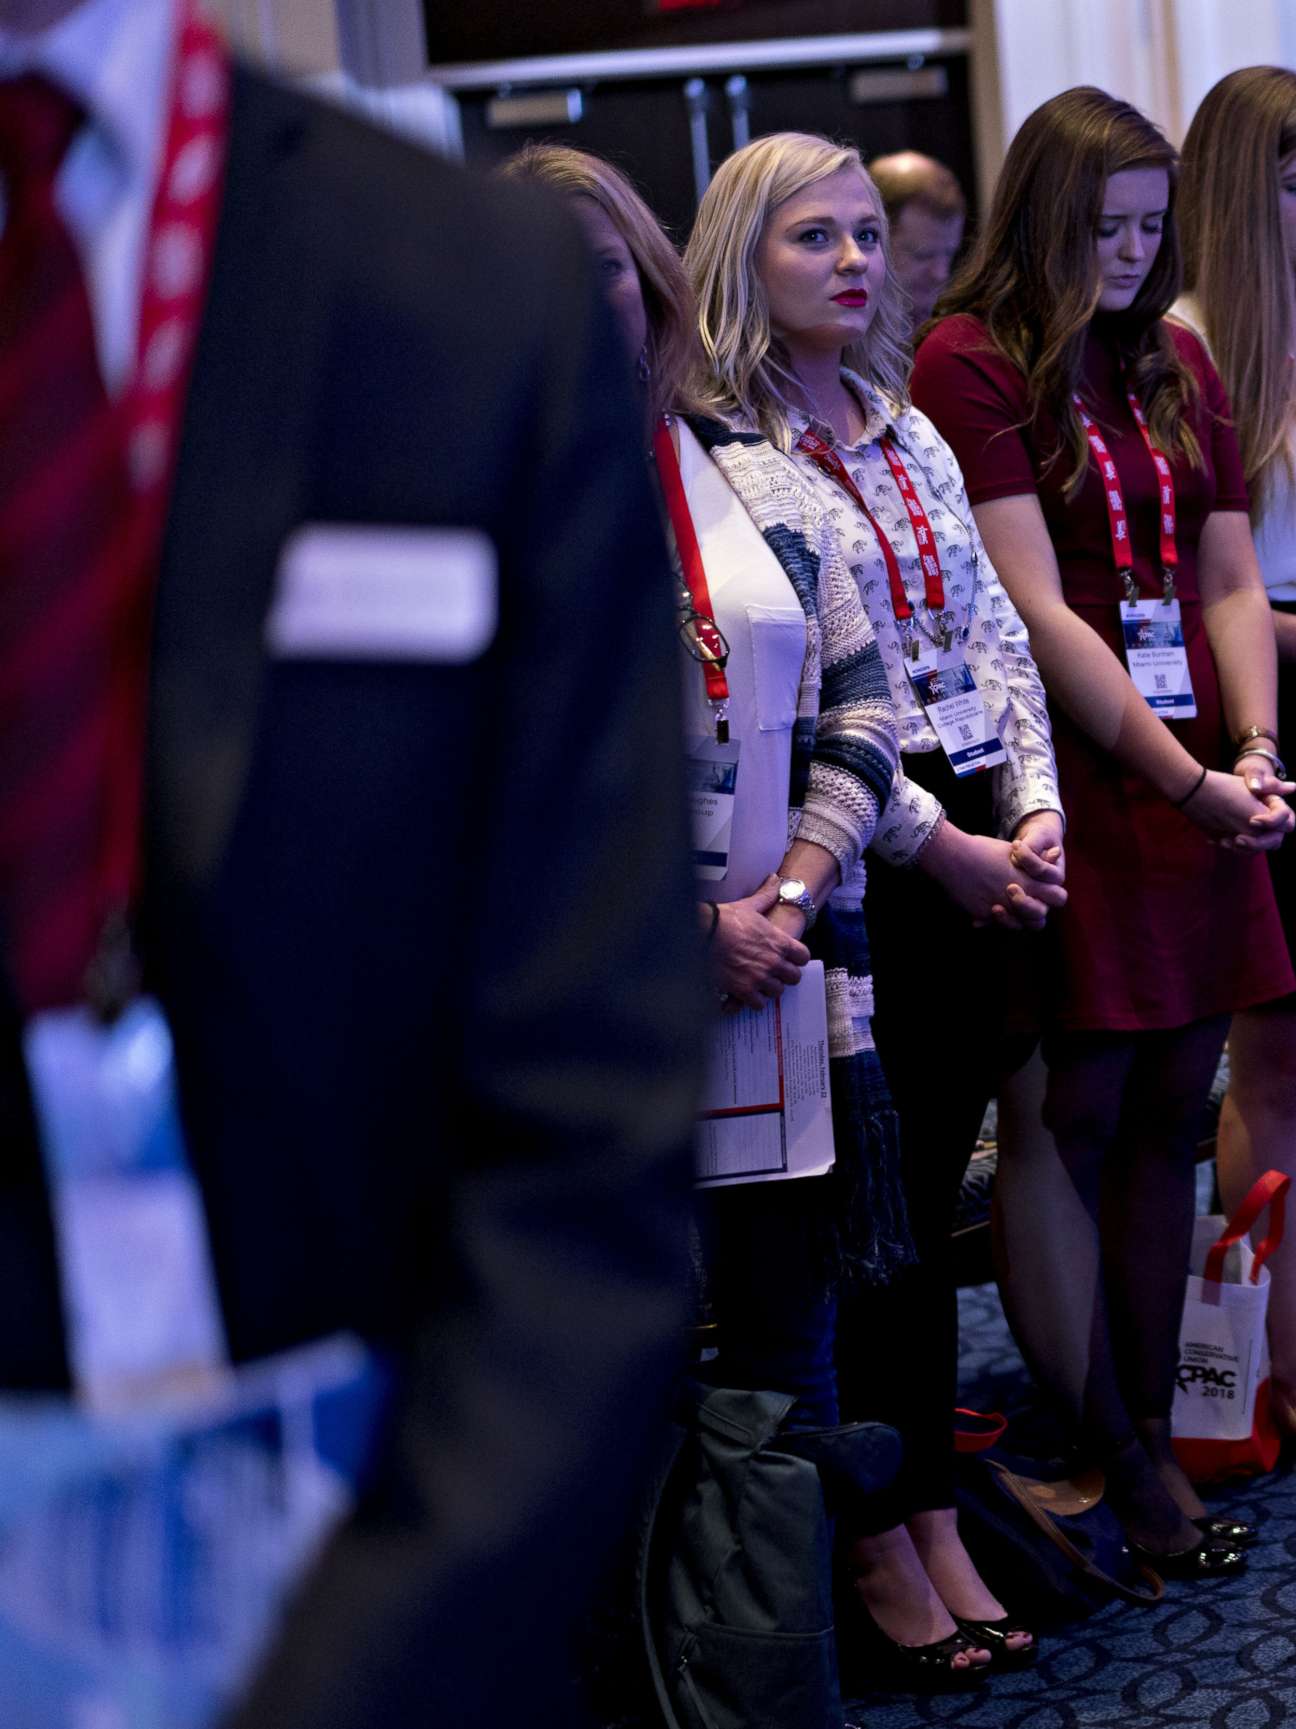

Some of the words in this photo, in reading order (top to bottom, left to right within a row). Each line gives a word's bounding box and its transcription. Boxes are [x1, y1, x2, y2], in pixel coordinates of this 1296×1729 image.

[1152, 659, 1184, 667] University
[966, 747, 985, 758] Student
[1185, 1341, 1224, 1353] AMERICAN
[1184, 1347, 1239, 1363] CONSERVATIVE
[1184, 1355, 1208, 1365] UNION
[1176, 1364, 1237, 1388] CPAC
[1202, 1386, 1236, 1400] 2018
